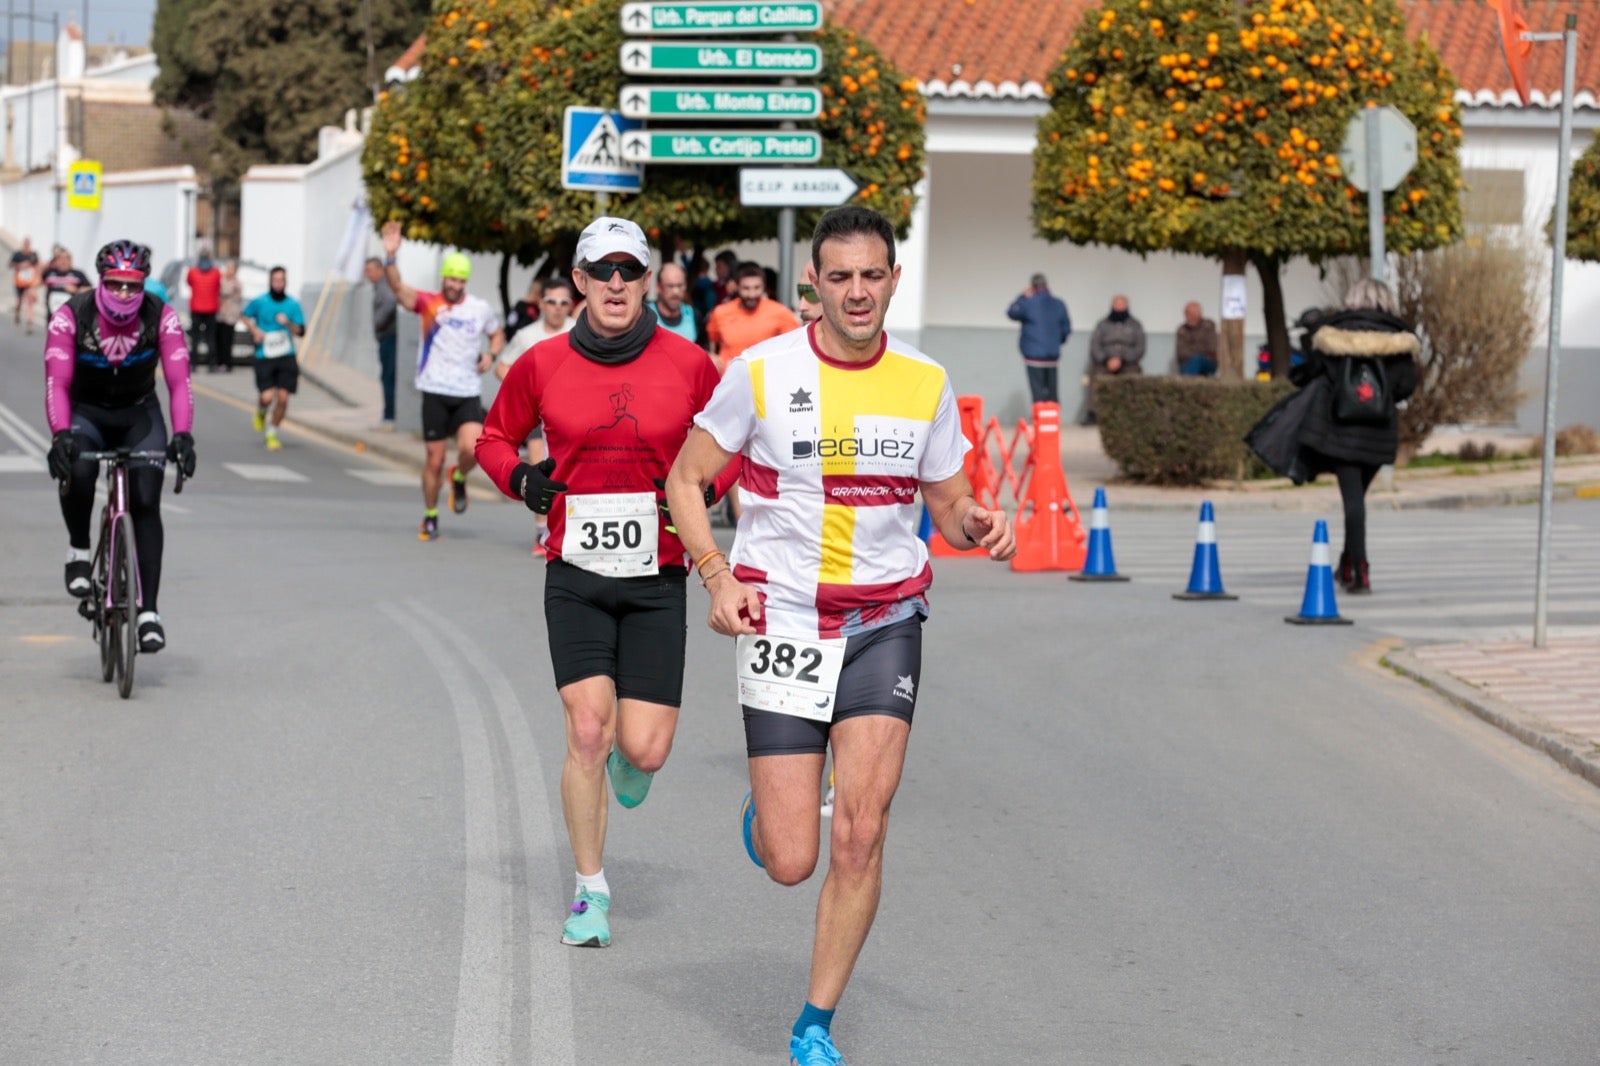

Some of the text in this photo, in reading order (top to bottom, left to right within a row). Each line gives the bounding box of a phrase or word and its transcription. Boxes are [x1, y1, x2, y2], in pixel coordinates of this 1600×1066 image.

[653, 8, 684, 26] Urb.
[685, 7, 734, 28] Parque
[735, 7, 759, 25] del
[698, 49, 732, 66] Urb.
[735, 49, 753, 66] El
[676, 93, 812, 111] Urb. Monte Elvira
[672, 137, 706, 154] Urb.
[709, 137, 762, 157] Cortijo
[789, 405, 814, 413] luanvi
[580, 520, 642, 550] 350
[750, 639, 823, 684] 382
